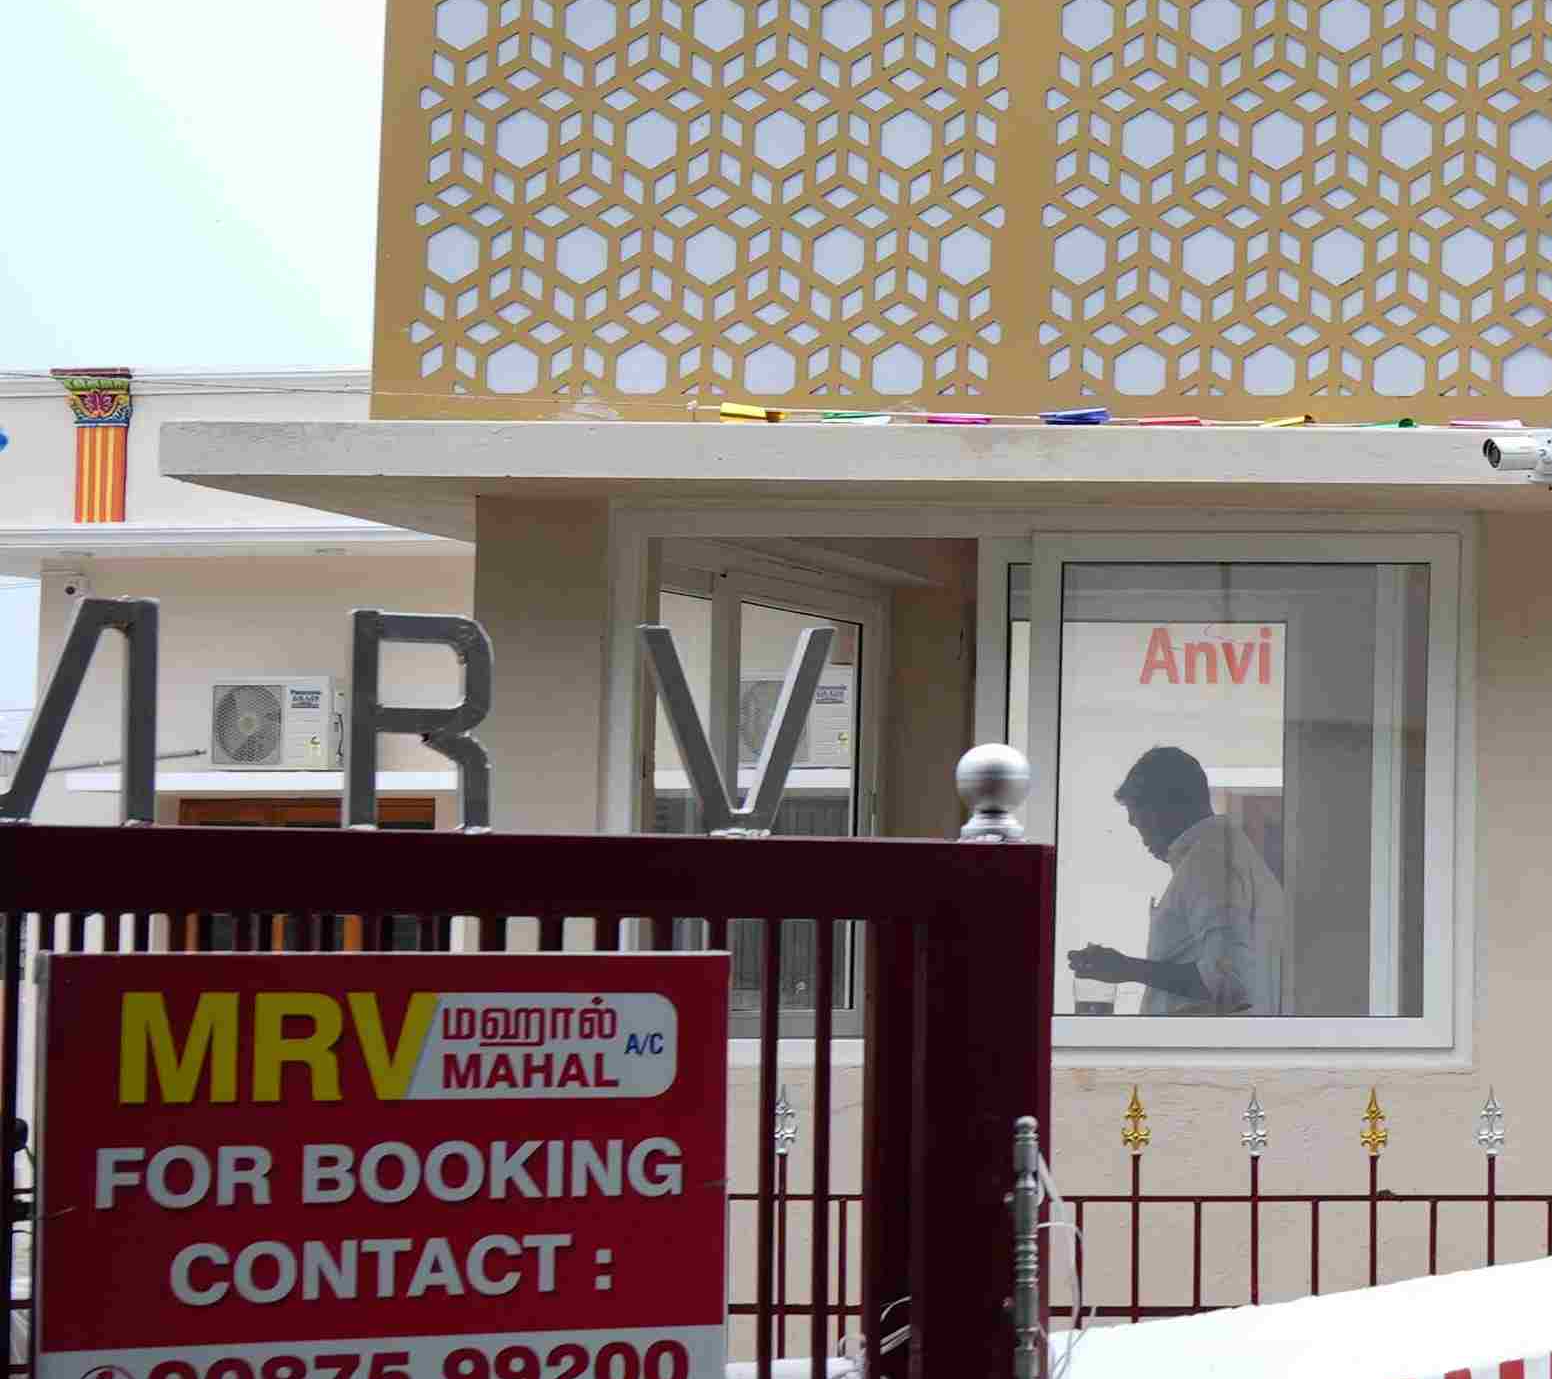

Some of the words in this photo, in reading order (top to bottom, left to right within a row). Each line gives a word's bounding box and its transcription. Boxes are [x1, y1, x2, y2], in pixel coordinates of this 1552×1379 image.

[1139, 626, 1274, 685] Anvi
[118, 991, 441, 1104] MRV
[442, 996, 618, 1047] மஹால்
[624, 1032, 665, 1056] A/C
[442, 1052, 620, 1090] MAHAL
[95, 1145, 273, 1210] FOR
[302, 1137, 684, 1204] BOOKING
[169, 1233, 572, 1306] CONTACT
